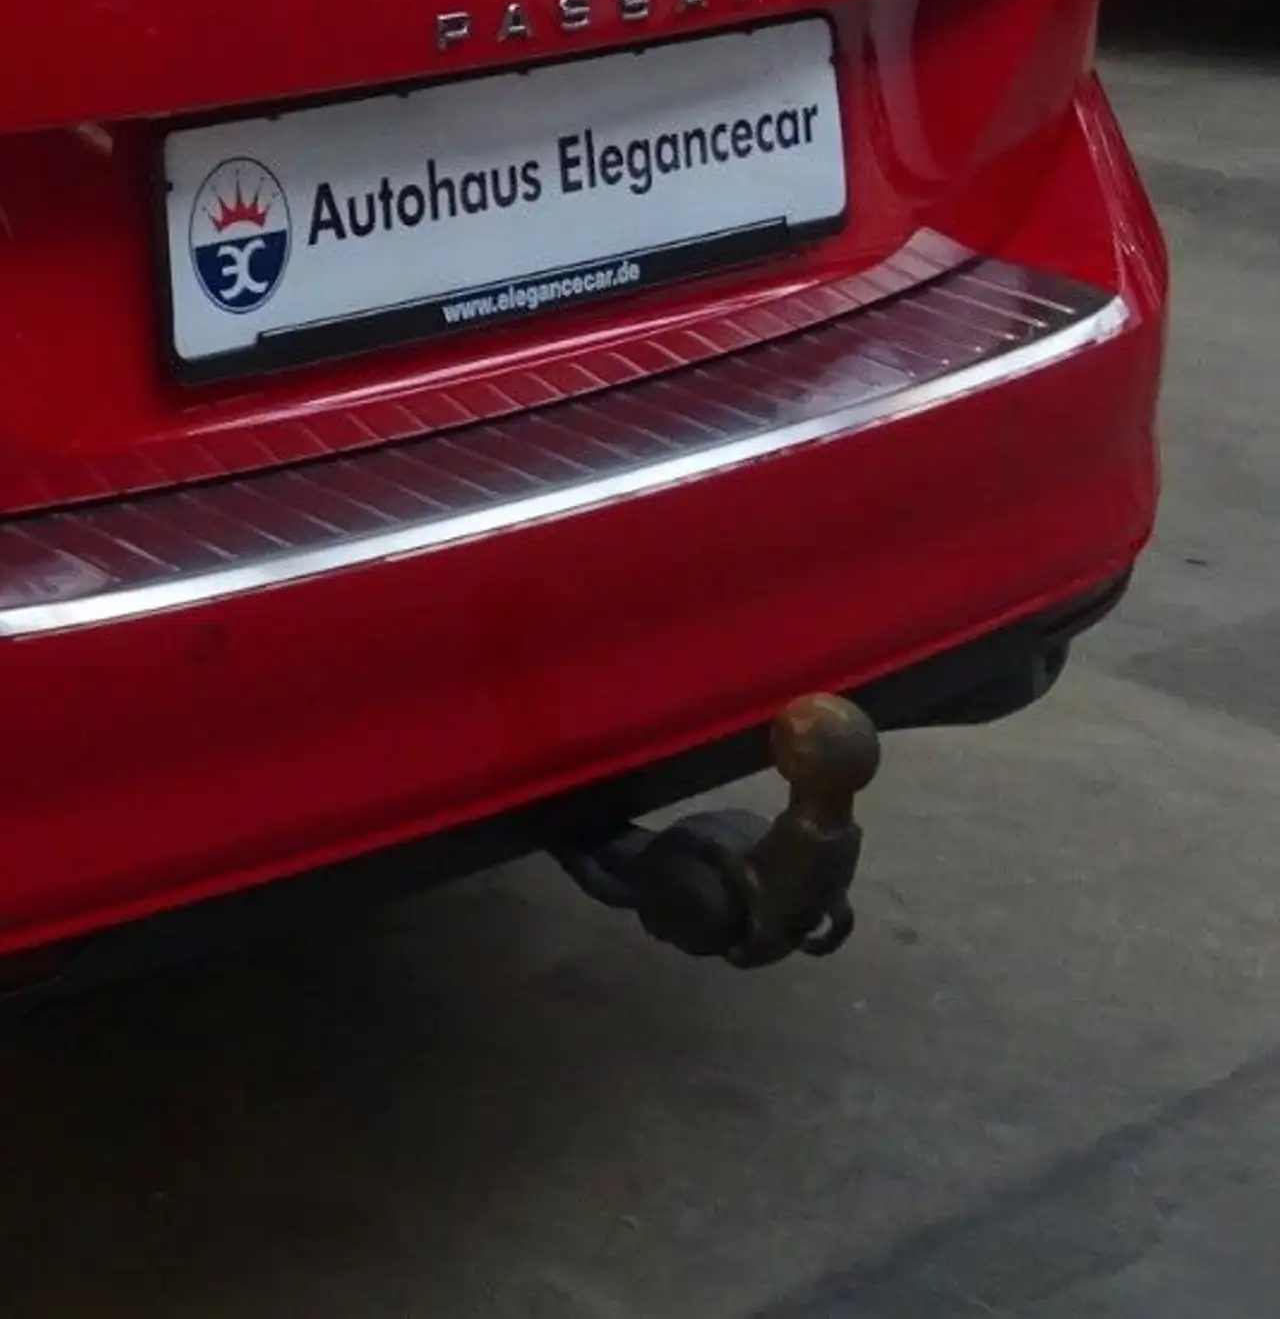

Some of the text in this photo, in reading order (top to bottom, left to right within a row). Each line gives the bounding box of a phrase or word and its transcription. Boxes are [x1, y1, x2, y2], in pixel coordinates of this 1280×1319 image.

[308, 103, 819, 245] Autohaus Elegancecar
[442, 260, 640, 323] www.elegancecar.de
